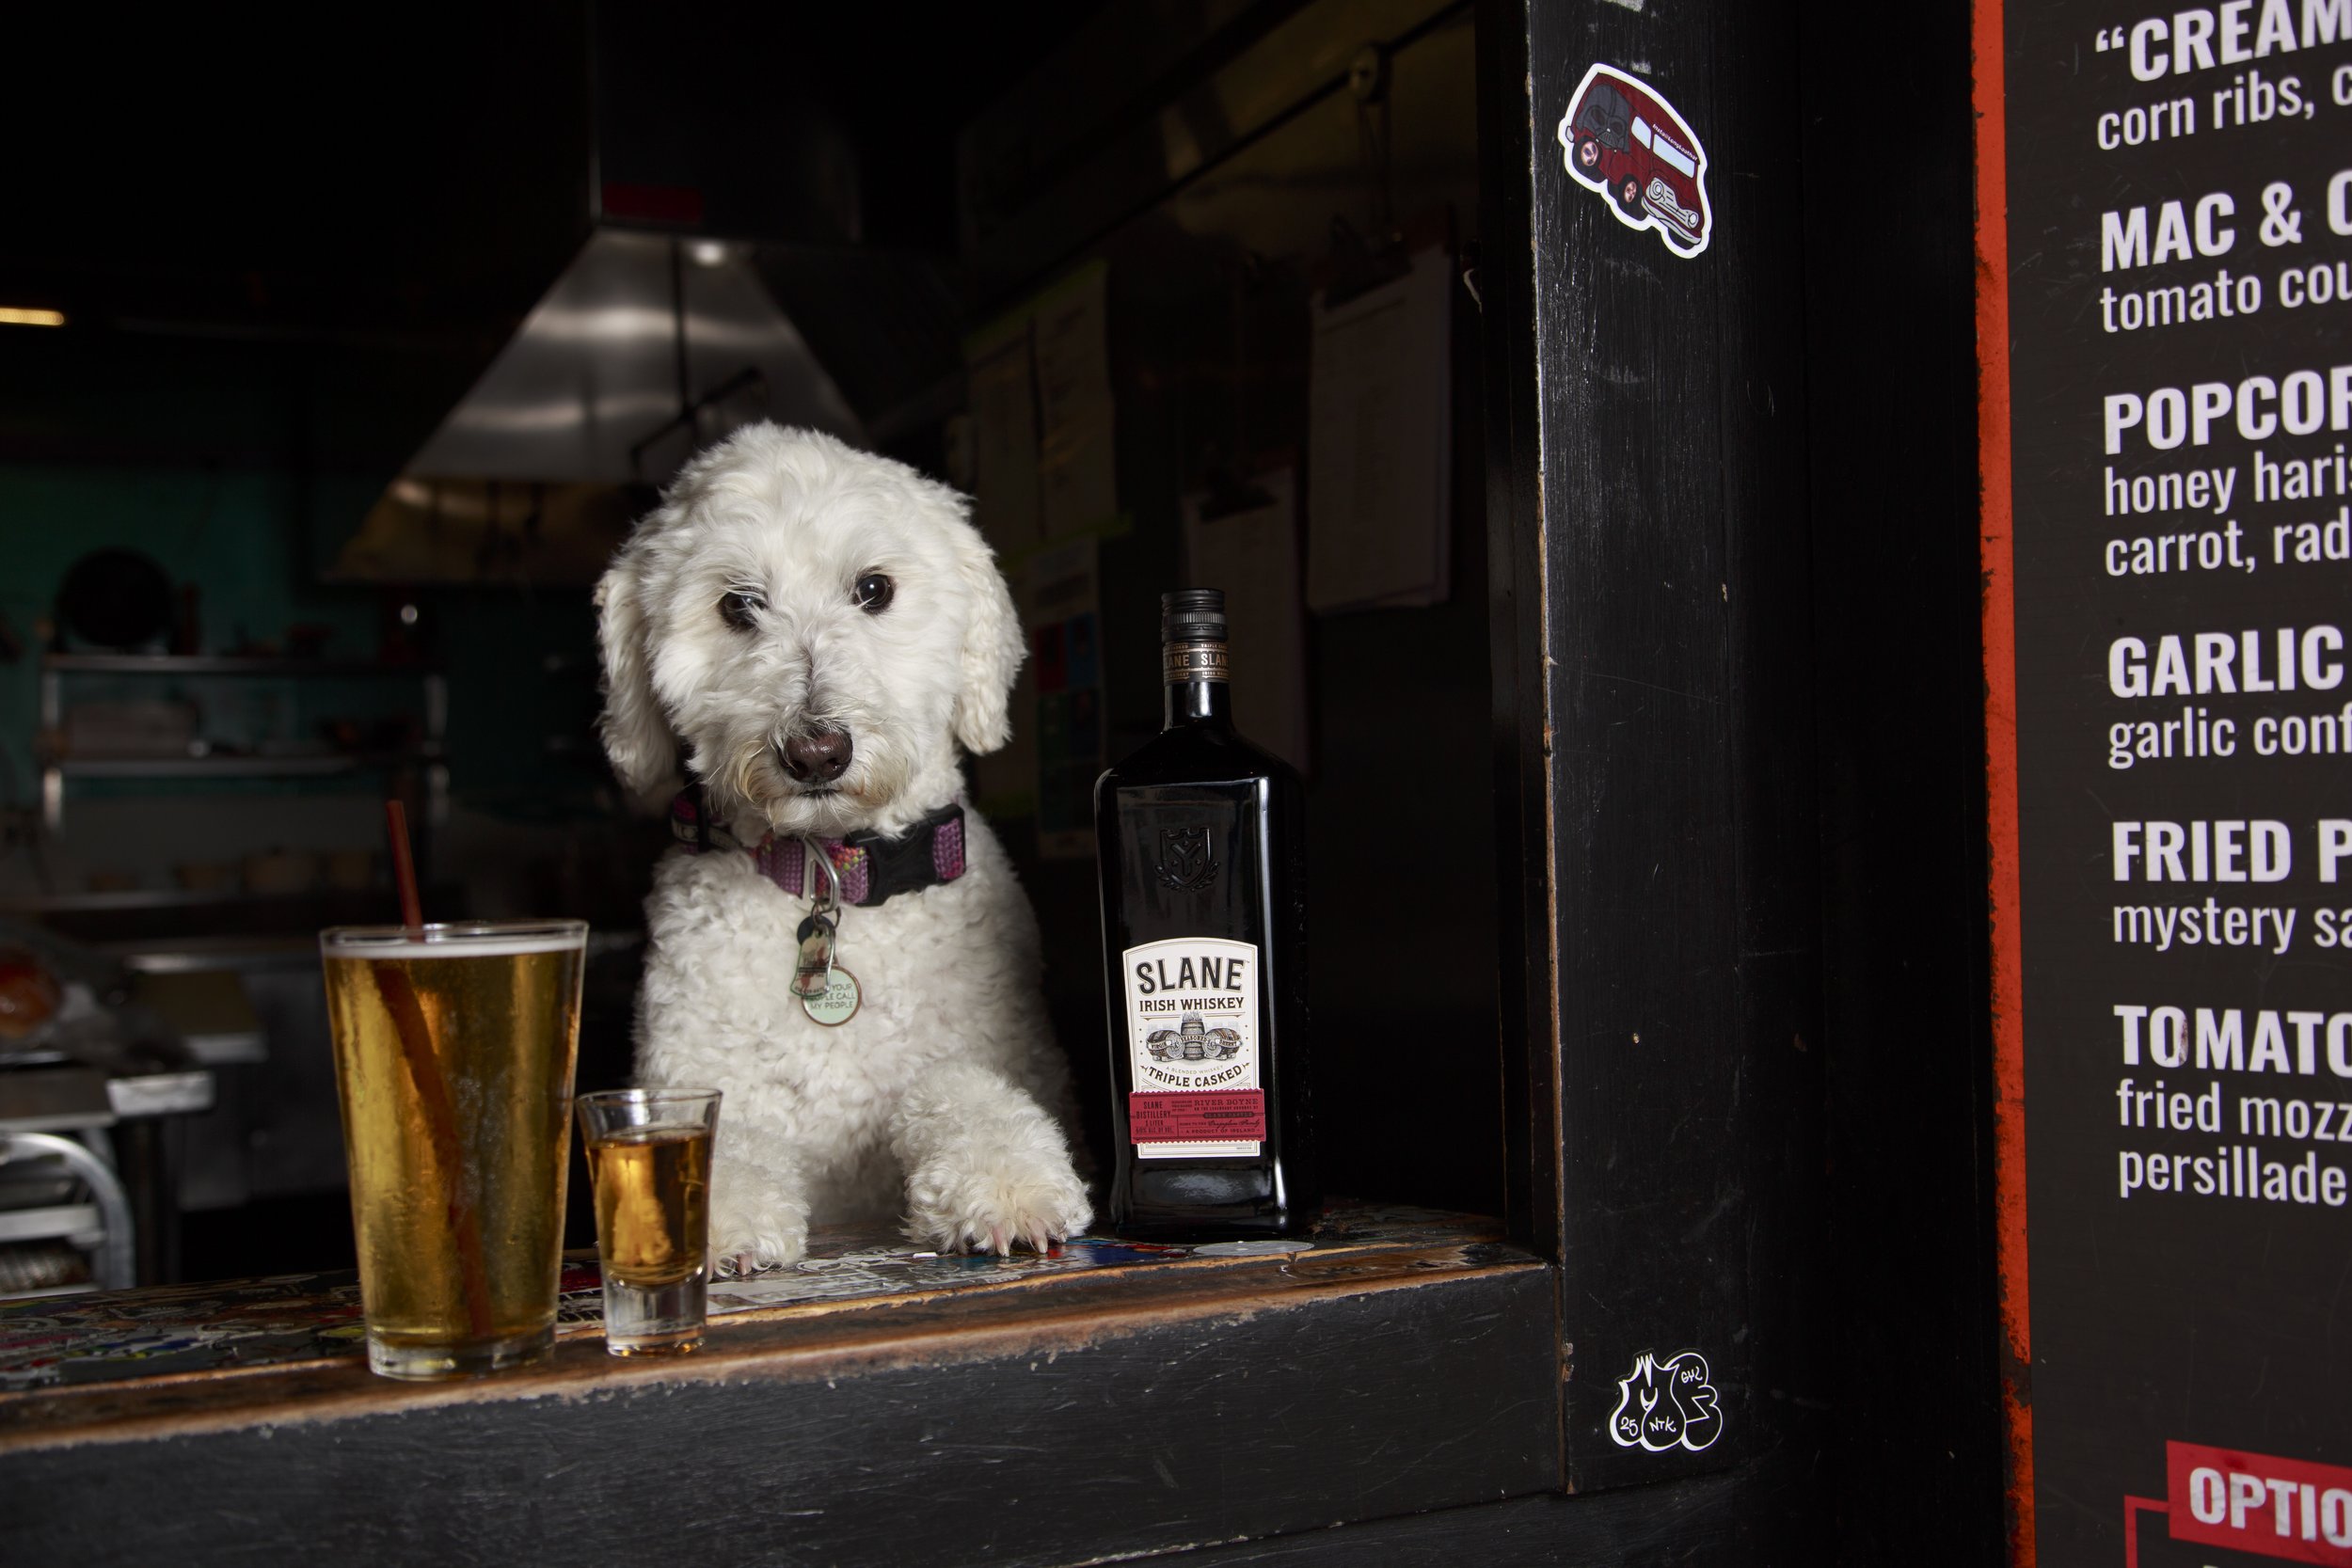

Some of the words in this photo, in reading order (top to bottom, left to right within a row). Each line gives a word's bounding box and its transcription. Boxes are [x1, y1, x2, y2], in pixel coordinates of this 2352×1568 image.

[2097, 97, 2195, 150] corn
[2213, 70, 2315, 130] ribs,
[2101, 192, 2235, 273] MAC
[2259, 182, 2302, 247] &
[2099, 269, 2262, 333] tomato
[2105, 467, 2236, 516] honey
[2105, 519, 2256, 577] carrot,
[2273, 505, 2352, 564] rad
[2108, 625, 2344, 699] GARLIC
[2107, 705, 2236, 769] garlic
[2112, 819, 2292, 882] FRIED
[2113, 897, 2296, 955] mystery
[1136, 956, 1247, 995] SLANE
[824, 1001, 854, 1009] PEOPLE
[1139, 999, 1176, 1012] IRISH
[1181, 996, 1245, 1011] WHISKEY
[1148, 1066, 1190, 1087] TRIPLE
[1194, 1065, 1243, 1087] CASKED
[1171, 1067, 1198, 1075] BLENDED
[1199, 1065, 1224, 1074] WHISKEY
[1136, 1110, 1171, 1119] DISTILLERY
[1143, 1101, 1163, 1110] SLANE
[2115, 1078, 2221, 1132] fried
[2239, 1097, 2352, 1142] mozz
[2119, 1145, 2346, 1207] persillade
[1620, 1417, 1639, 1436] 25
[1649, 1416, 1677, 1432] NTK
